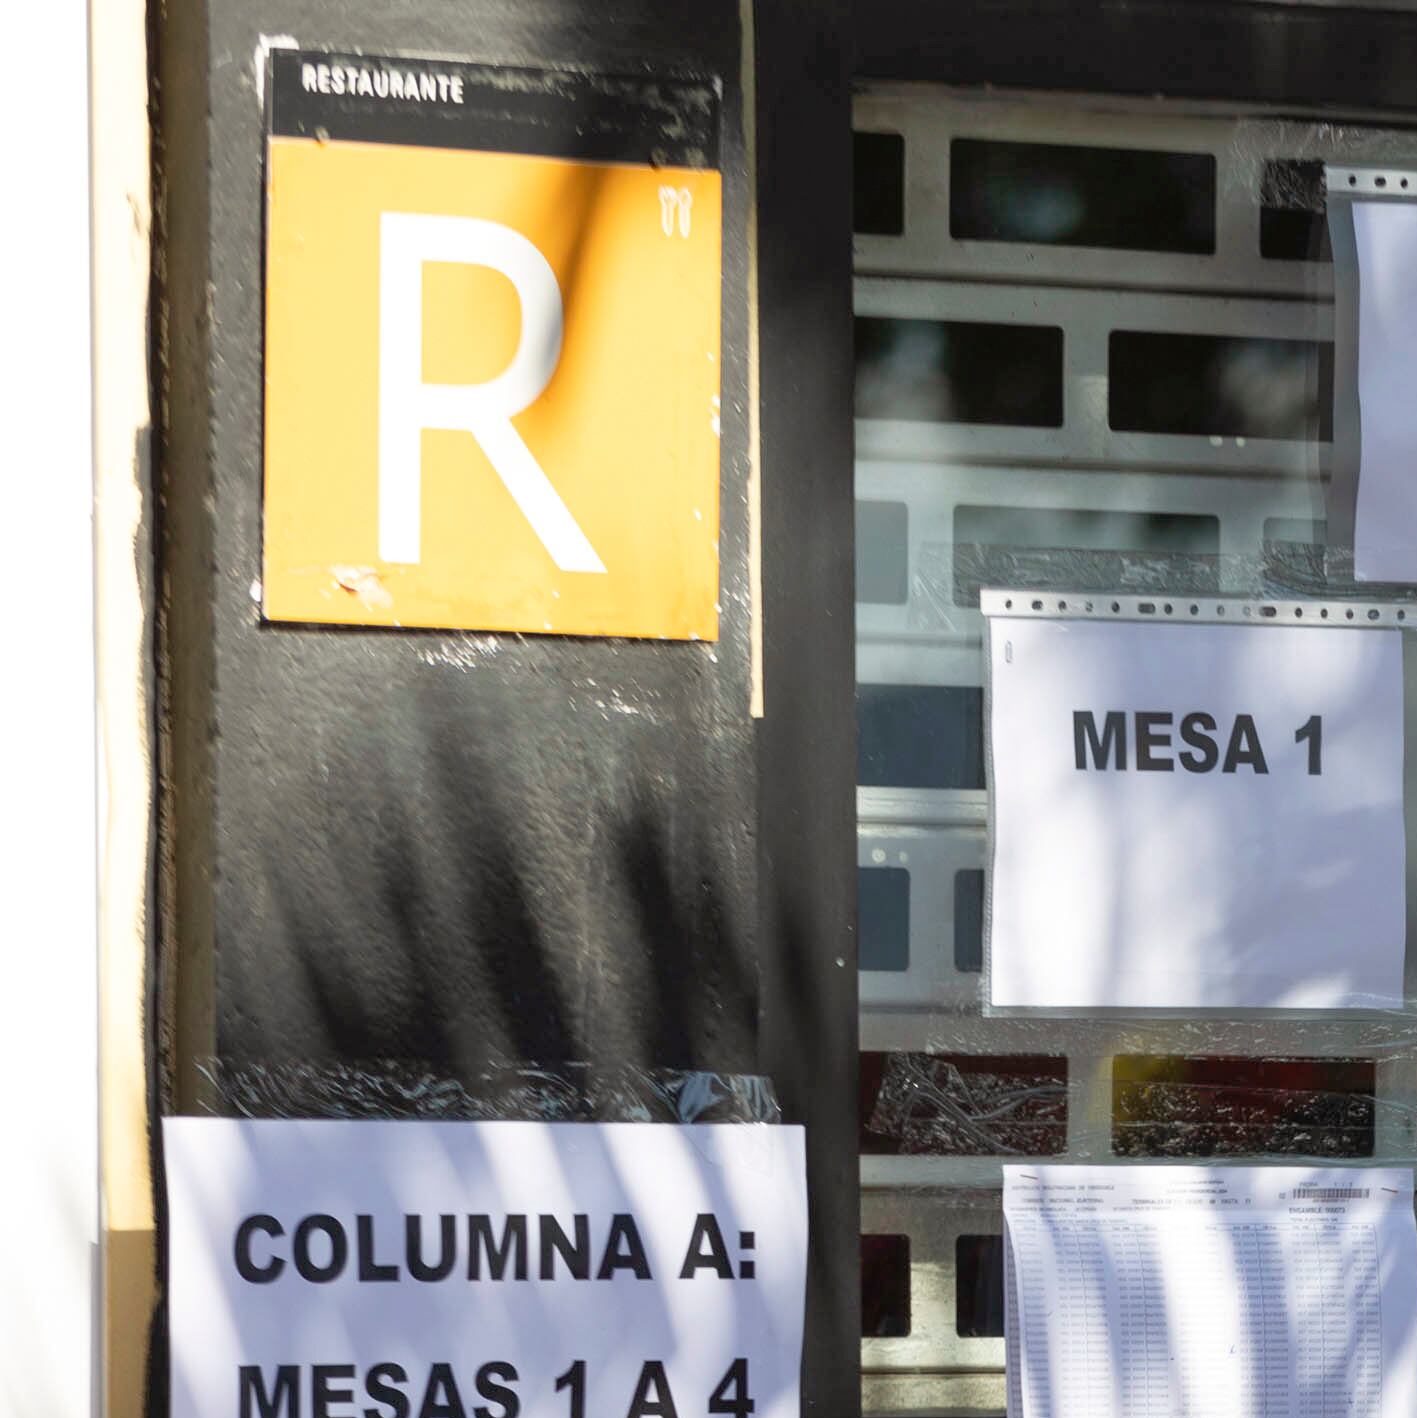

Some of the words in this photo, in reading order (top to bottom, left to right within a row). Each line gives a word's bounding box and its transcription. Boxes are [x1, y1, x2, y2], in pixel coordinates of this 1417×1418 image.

[301, 63, 465, 105] RESTAURANTE
[378, 211, 609, 576] R
[1072, 710, 1269, 775] MESA
[1295, 715, 1322, 776] 1
[233, 1212, 654, 1284] COLUMNA
[679, 1212, 756, 1281] A:
